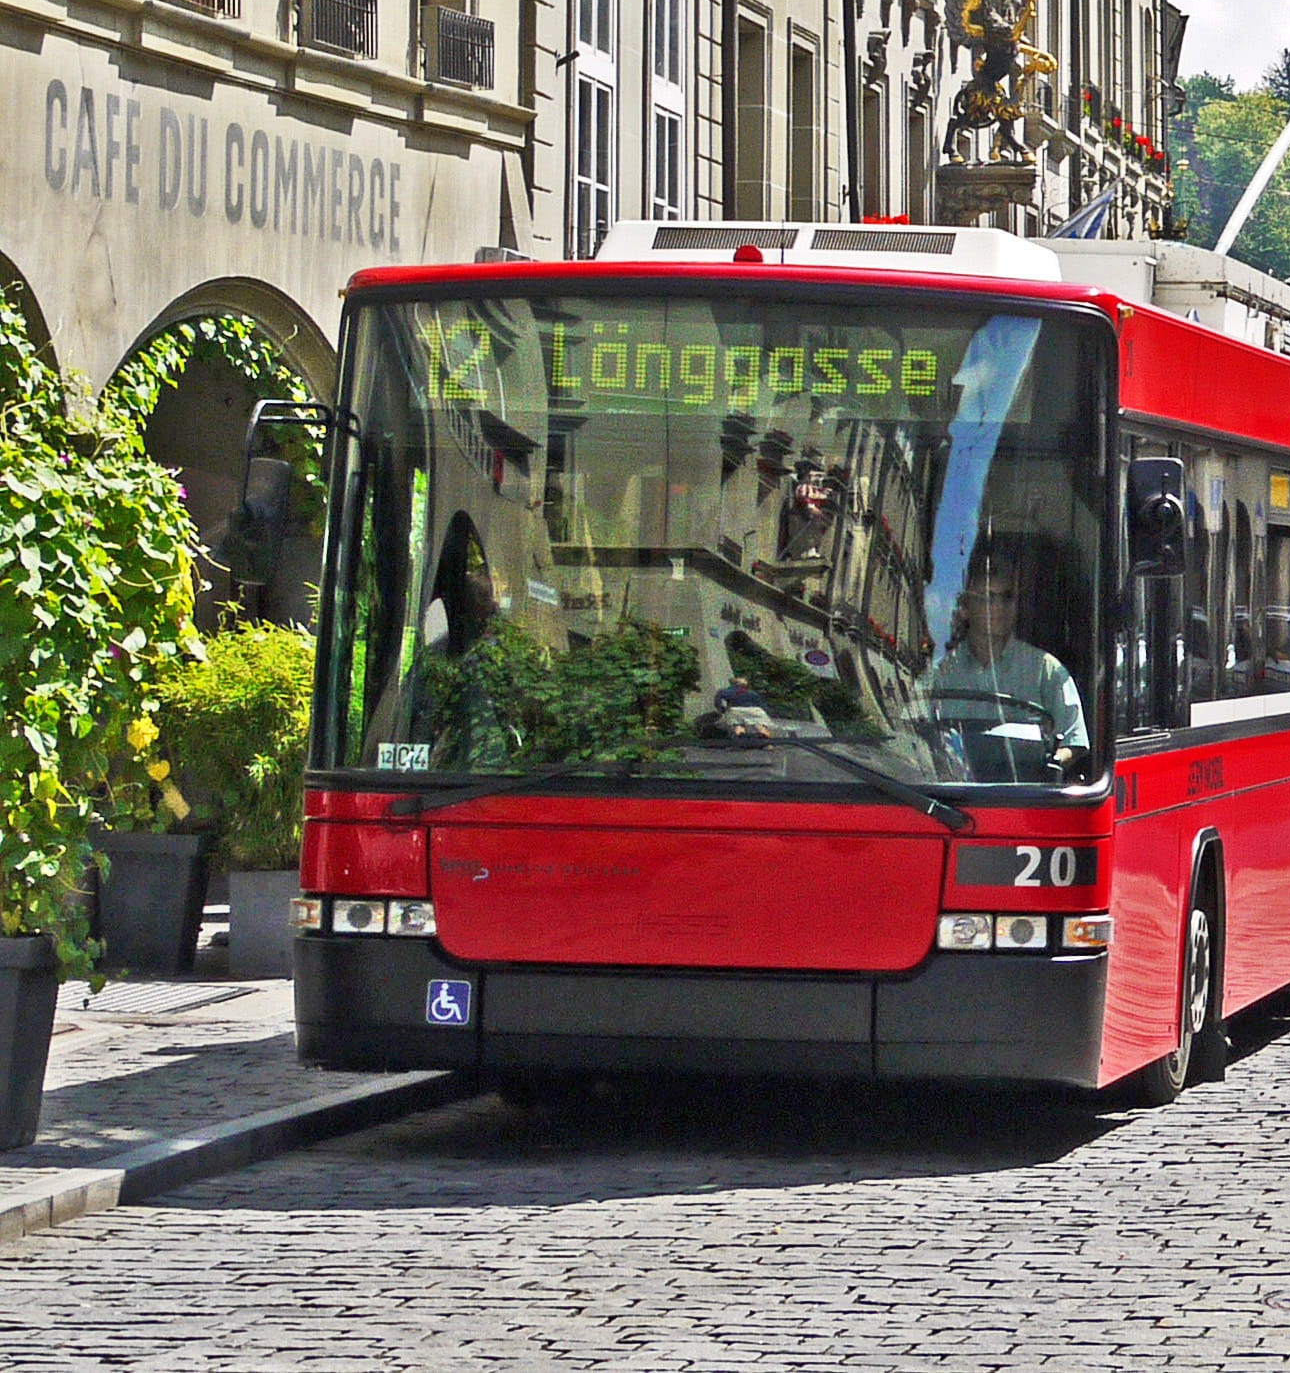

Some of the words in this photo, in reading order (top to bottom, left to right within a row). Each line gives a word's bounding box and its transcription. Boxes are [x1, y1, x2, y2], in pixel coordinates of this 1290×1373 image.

[45, 78, 142, 205] CAFÉ
[159, 105, 209, 218] DU
[225, 122, 401, 254] COMMERCE
[416, 320, 491, 401] 12
[1013, 844, 1077, 888] 20
